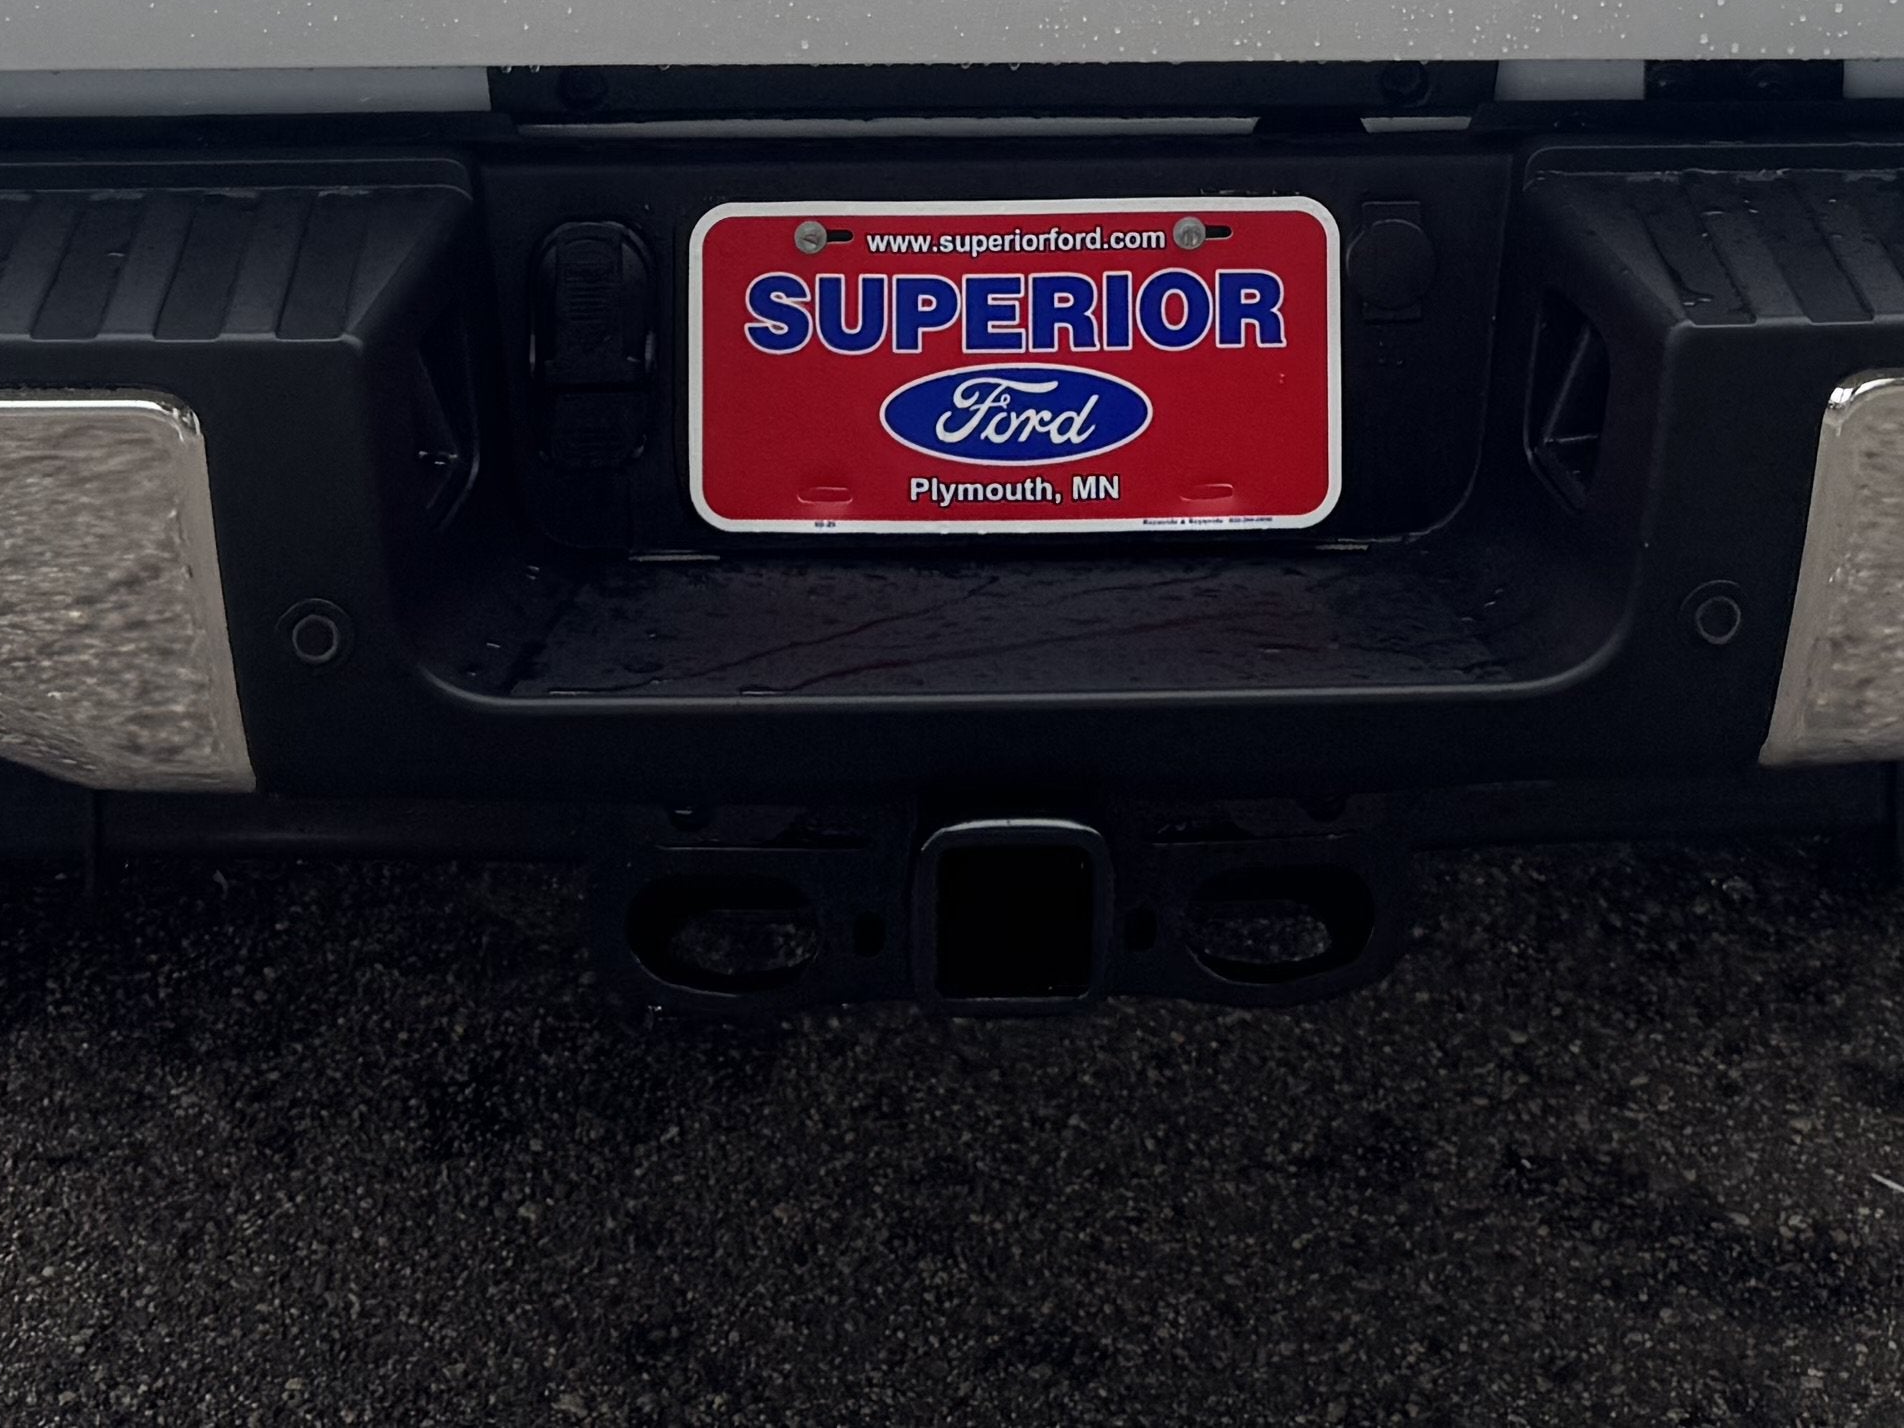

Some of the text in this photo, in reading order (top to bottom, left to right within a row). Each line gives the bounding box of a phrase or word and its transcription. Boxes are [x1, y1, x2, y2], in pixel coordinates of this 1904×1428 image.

[866, 226, 1166, 255] www.superiorford.com
[745, 268, 1287, 354] SUPERIOR
[935, 376, 1100, 446] Ford
[909, 475, 1121, 507] Plymouth, MN
